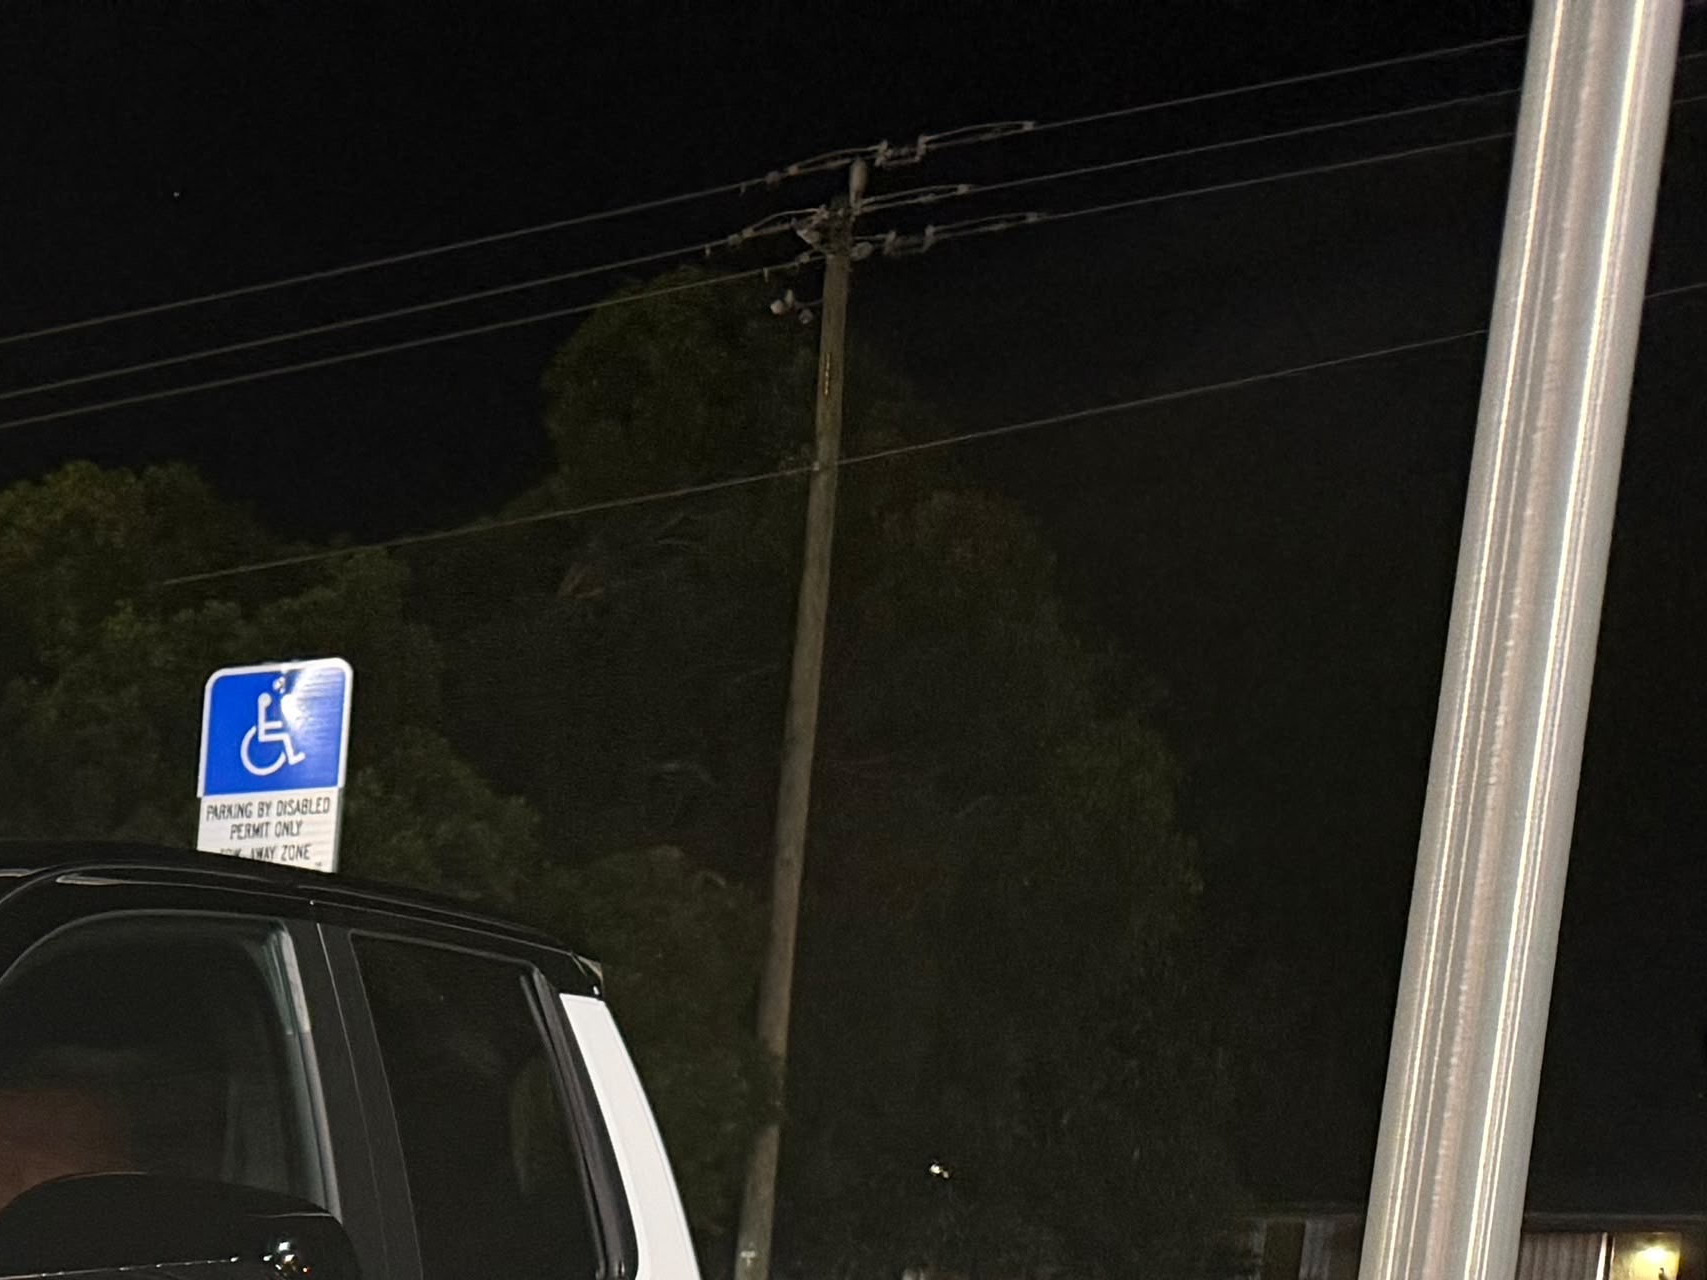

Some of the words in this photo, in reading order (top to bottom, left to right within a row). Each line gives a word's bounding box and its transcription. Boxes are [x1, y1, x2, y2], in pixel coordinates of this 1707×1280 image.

[206, 801, 253, 821] PARKING
[257, 801, 272, 818] BY
[276, 797, 331, 816] DISABLED
[230, 821, 270, 840] PERMIT
[274, 819, 303, 838] ONLY
[281, 844, 312, 862] ZONE
